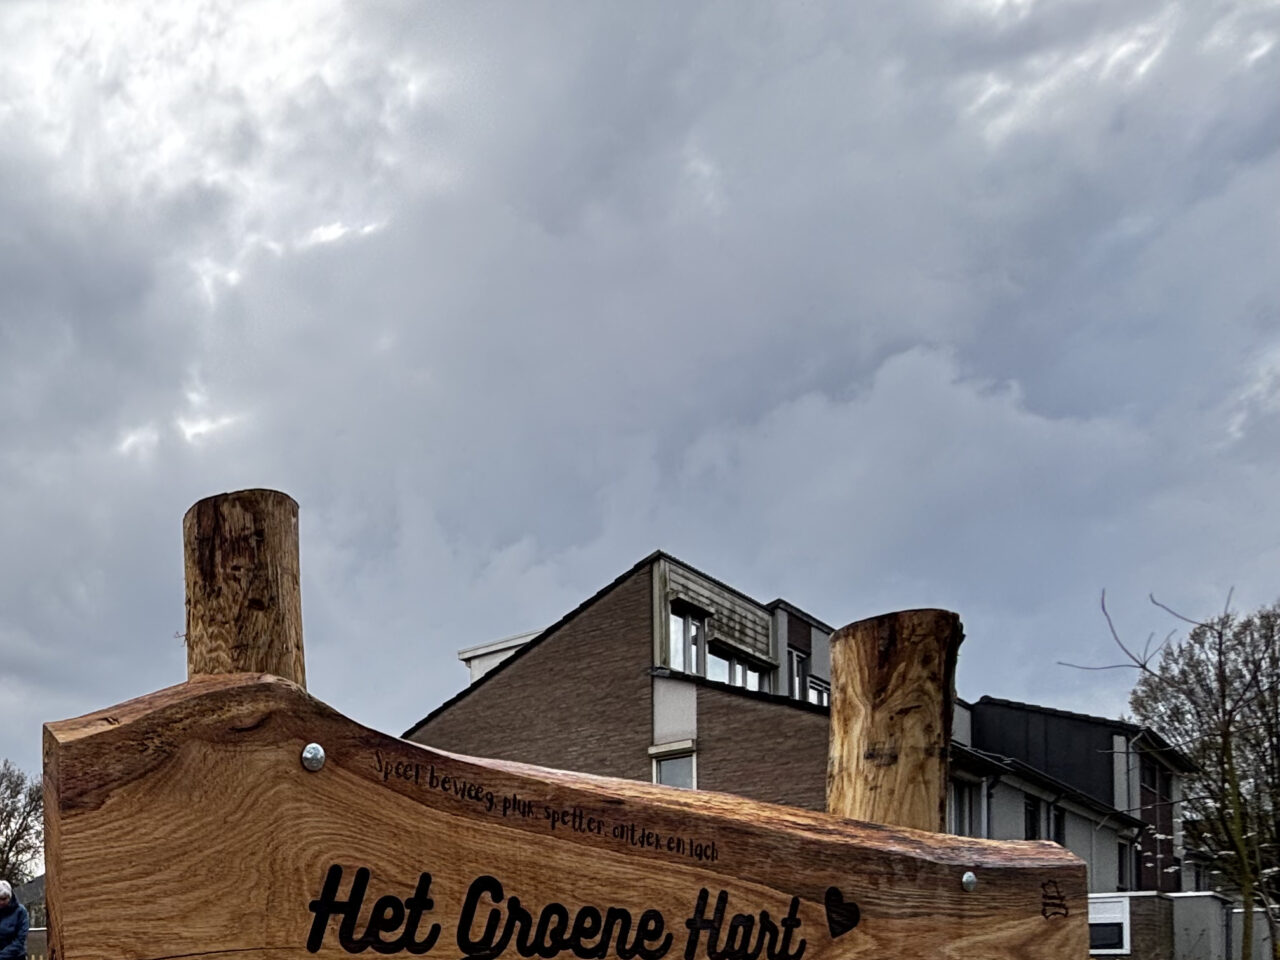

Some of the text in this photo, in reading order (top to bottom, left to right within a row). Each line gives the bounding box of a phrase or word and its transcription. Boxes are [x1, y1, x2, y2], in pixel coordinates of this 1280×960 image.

[613, 823, 663, 850] ontdek
[667, 836, 686, 855] en
[689, 839, 718, 862] lach
[306, 863, 441, 955] Het
